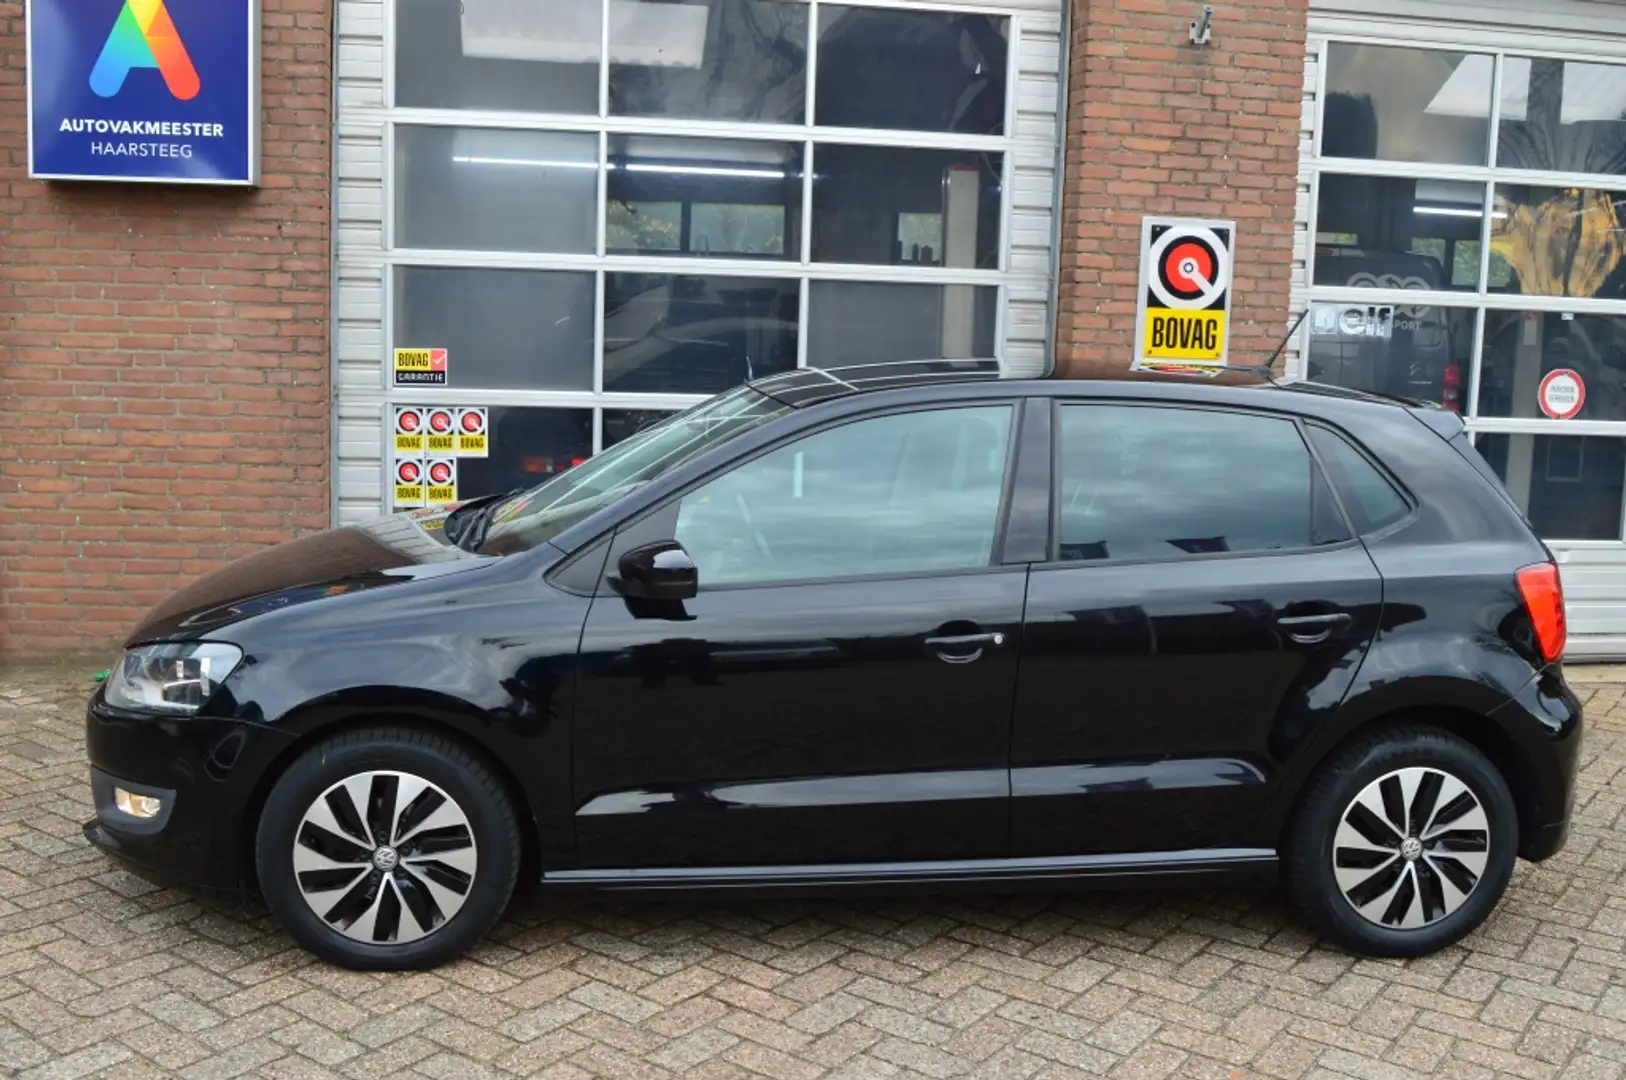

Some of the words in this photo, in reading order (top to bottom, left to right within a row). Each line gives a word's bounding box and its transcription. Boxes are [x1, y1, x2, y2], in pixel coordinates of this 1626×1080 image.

[59, 118, 224, 137] AUTOVAKMEESTER
[91, 141, 193, 159] HAARSTEEG
[1151, 317, 1218, 350] BOVAG
[398, 352, 429, 367] BOVAG
[397, 372, 445, 383] GARANTIE
[396, 437, 421, 449] BOVAG
[428, 437, 453, 449] BOVAG
[460, 437, 484, 449] BOVAG
[396, 487, 421, 499] BOVAG
[428, 488, 453, 500] BOVAG
